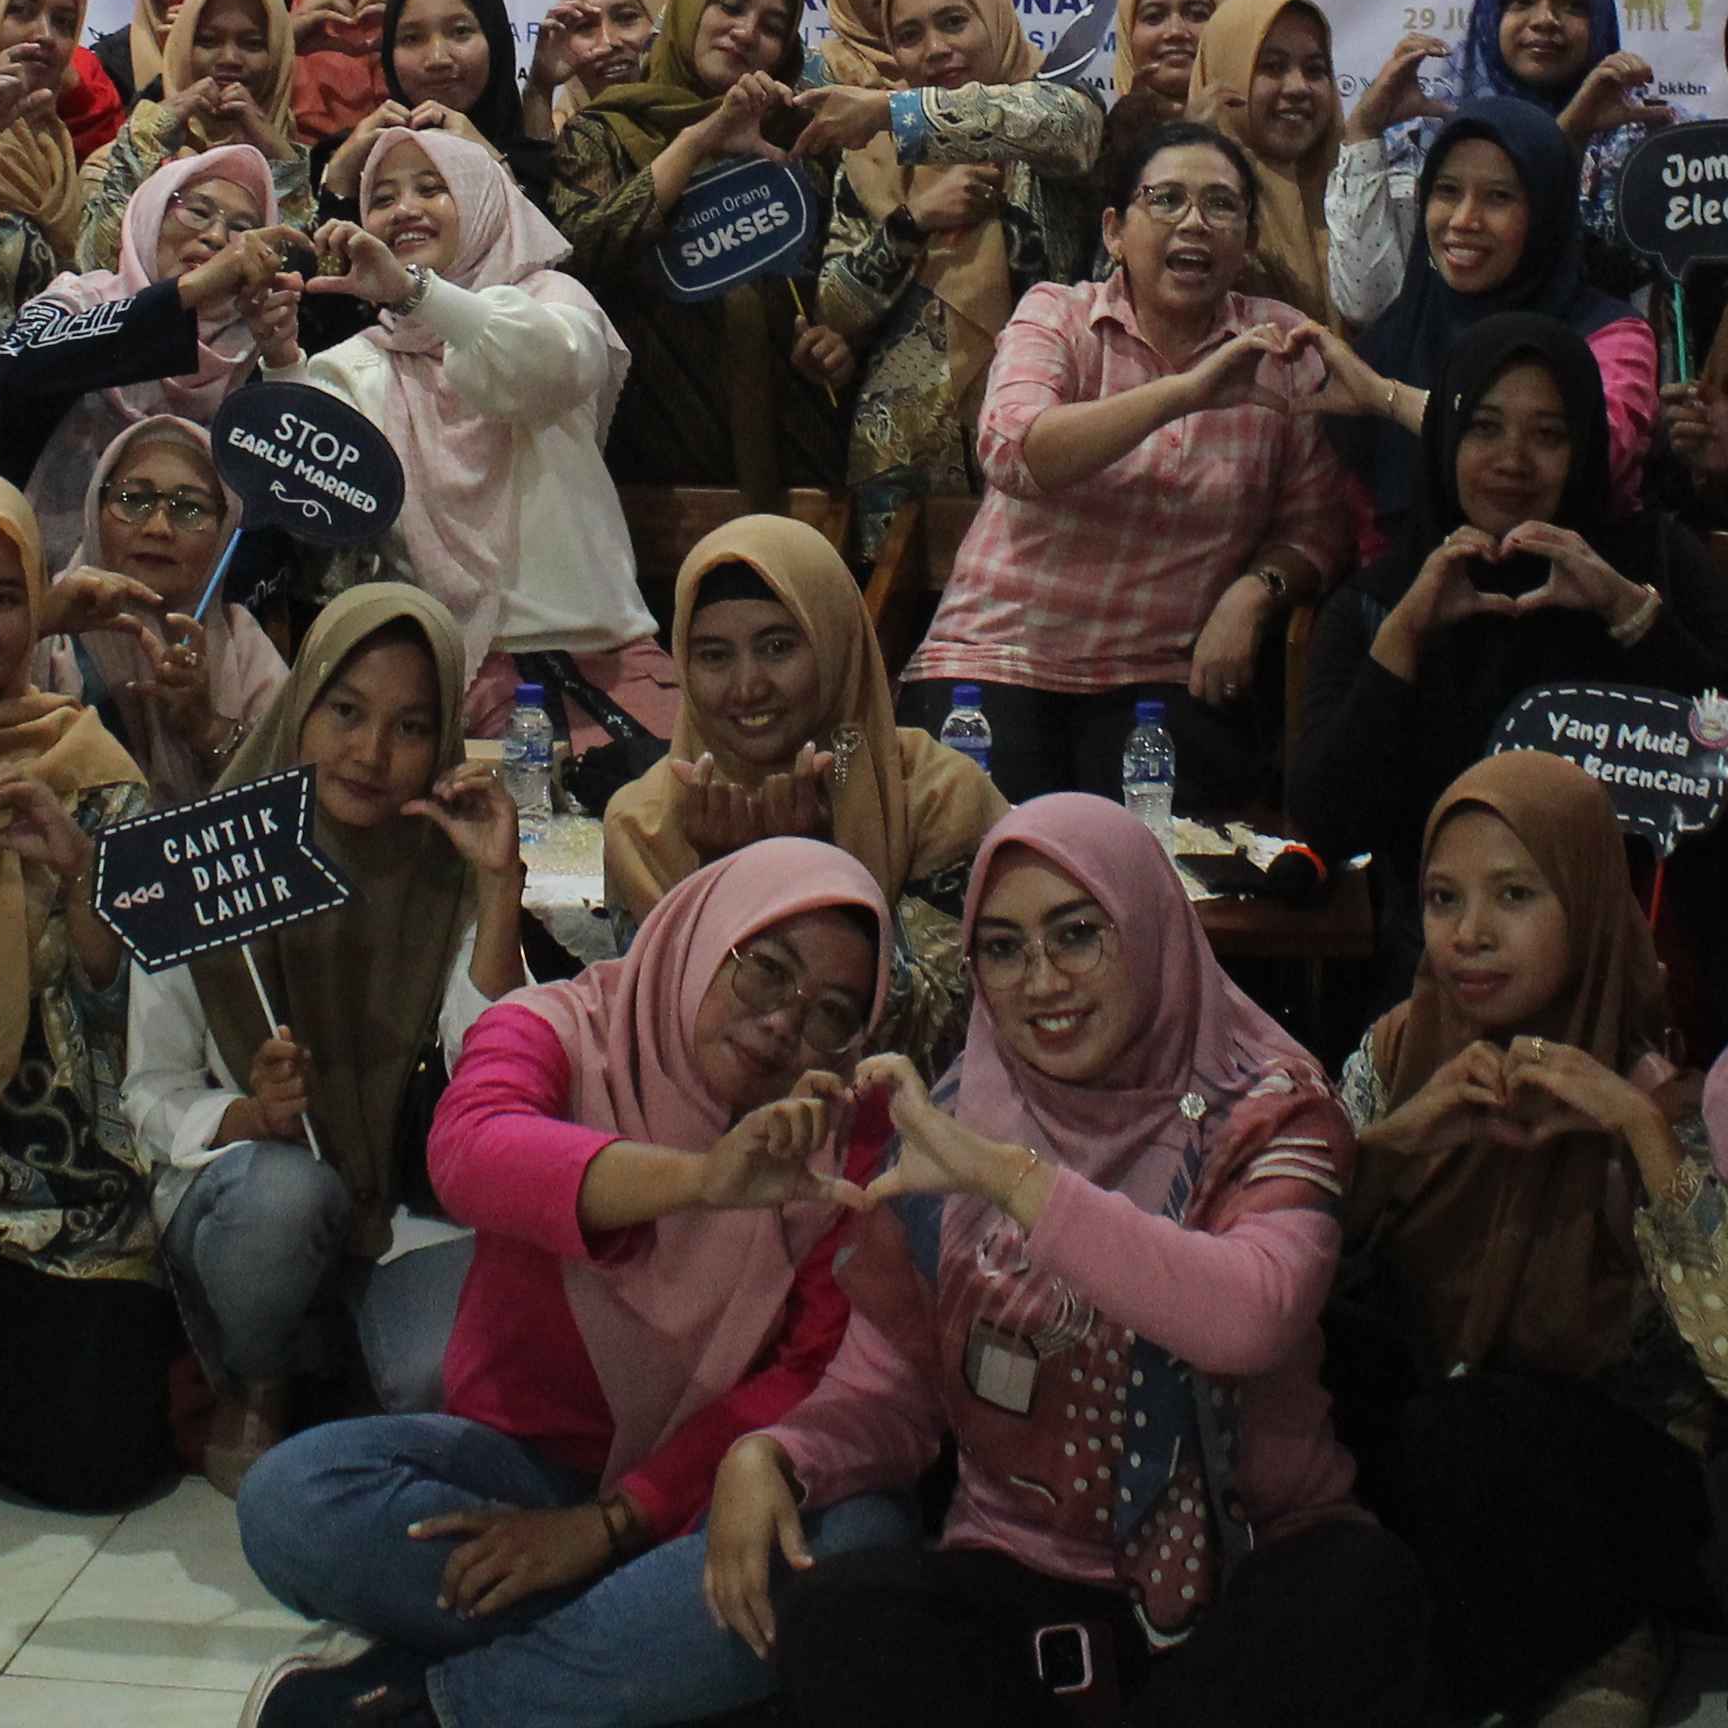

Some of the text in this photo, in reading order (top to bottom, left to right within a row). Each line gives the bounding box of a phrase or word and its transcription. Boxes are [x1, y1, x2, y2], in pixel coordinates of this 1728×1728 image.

[1403, 7, 1436, 30] 29
[722, 183, 771, 212] Orang
[680, 201, 791, 267] SUKSES
[274, 412, 360, 470] STOP
[228, 426, 378, 514] EARLY MARRIED
[1548, 711, 1610, 750] Yang
[1616, 723, 1690, 758] Muda
[163, 807, 279, 864] CANTIK
[191, 847, 266, 892] DARI
[194, 875, 292, 926] LAHIR
